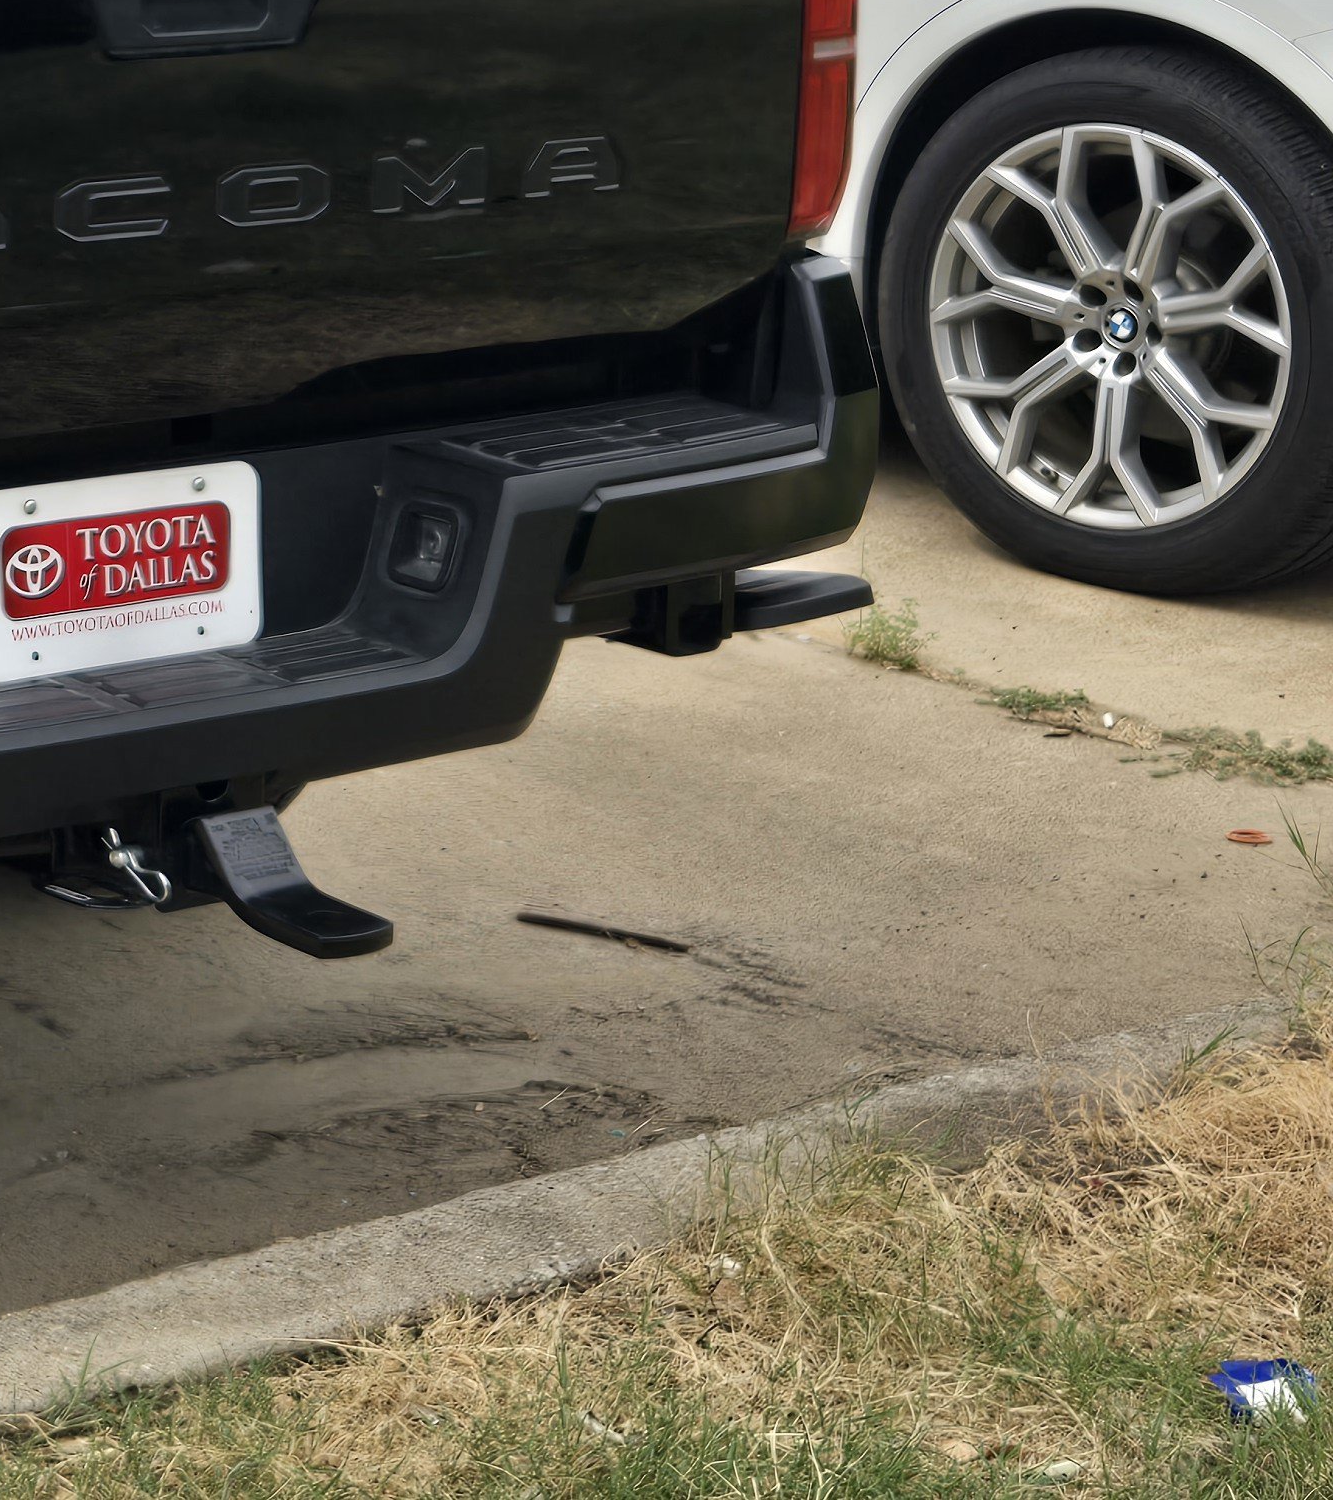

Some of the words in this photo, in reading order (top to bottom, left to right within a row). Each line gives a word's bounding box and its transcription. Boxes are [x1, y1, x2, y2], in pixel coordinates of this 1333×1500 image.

[76, 513, 217, 562] TOYOTA
[79, 563, 98, 600] of
[104, 550, 217, 598] DALLAS
[11, 599, 225, 642] WWW.TOYOTAOFDALLAS.COM
